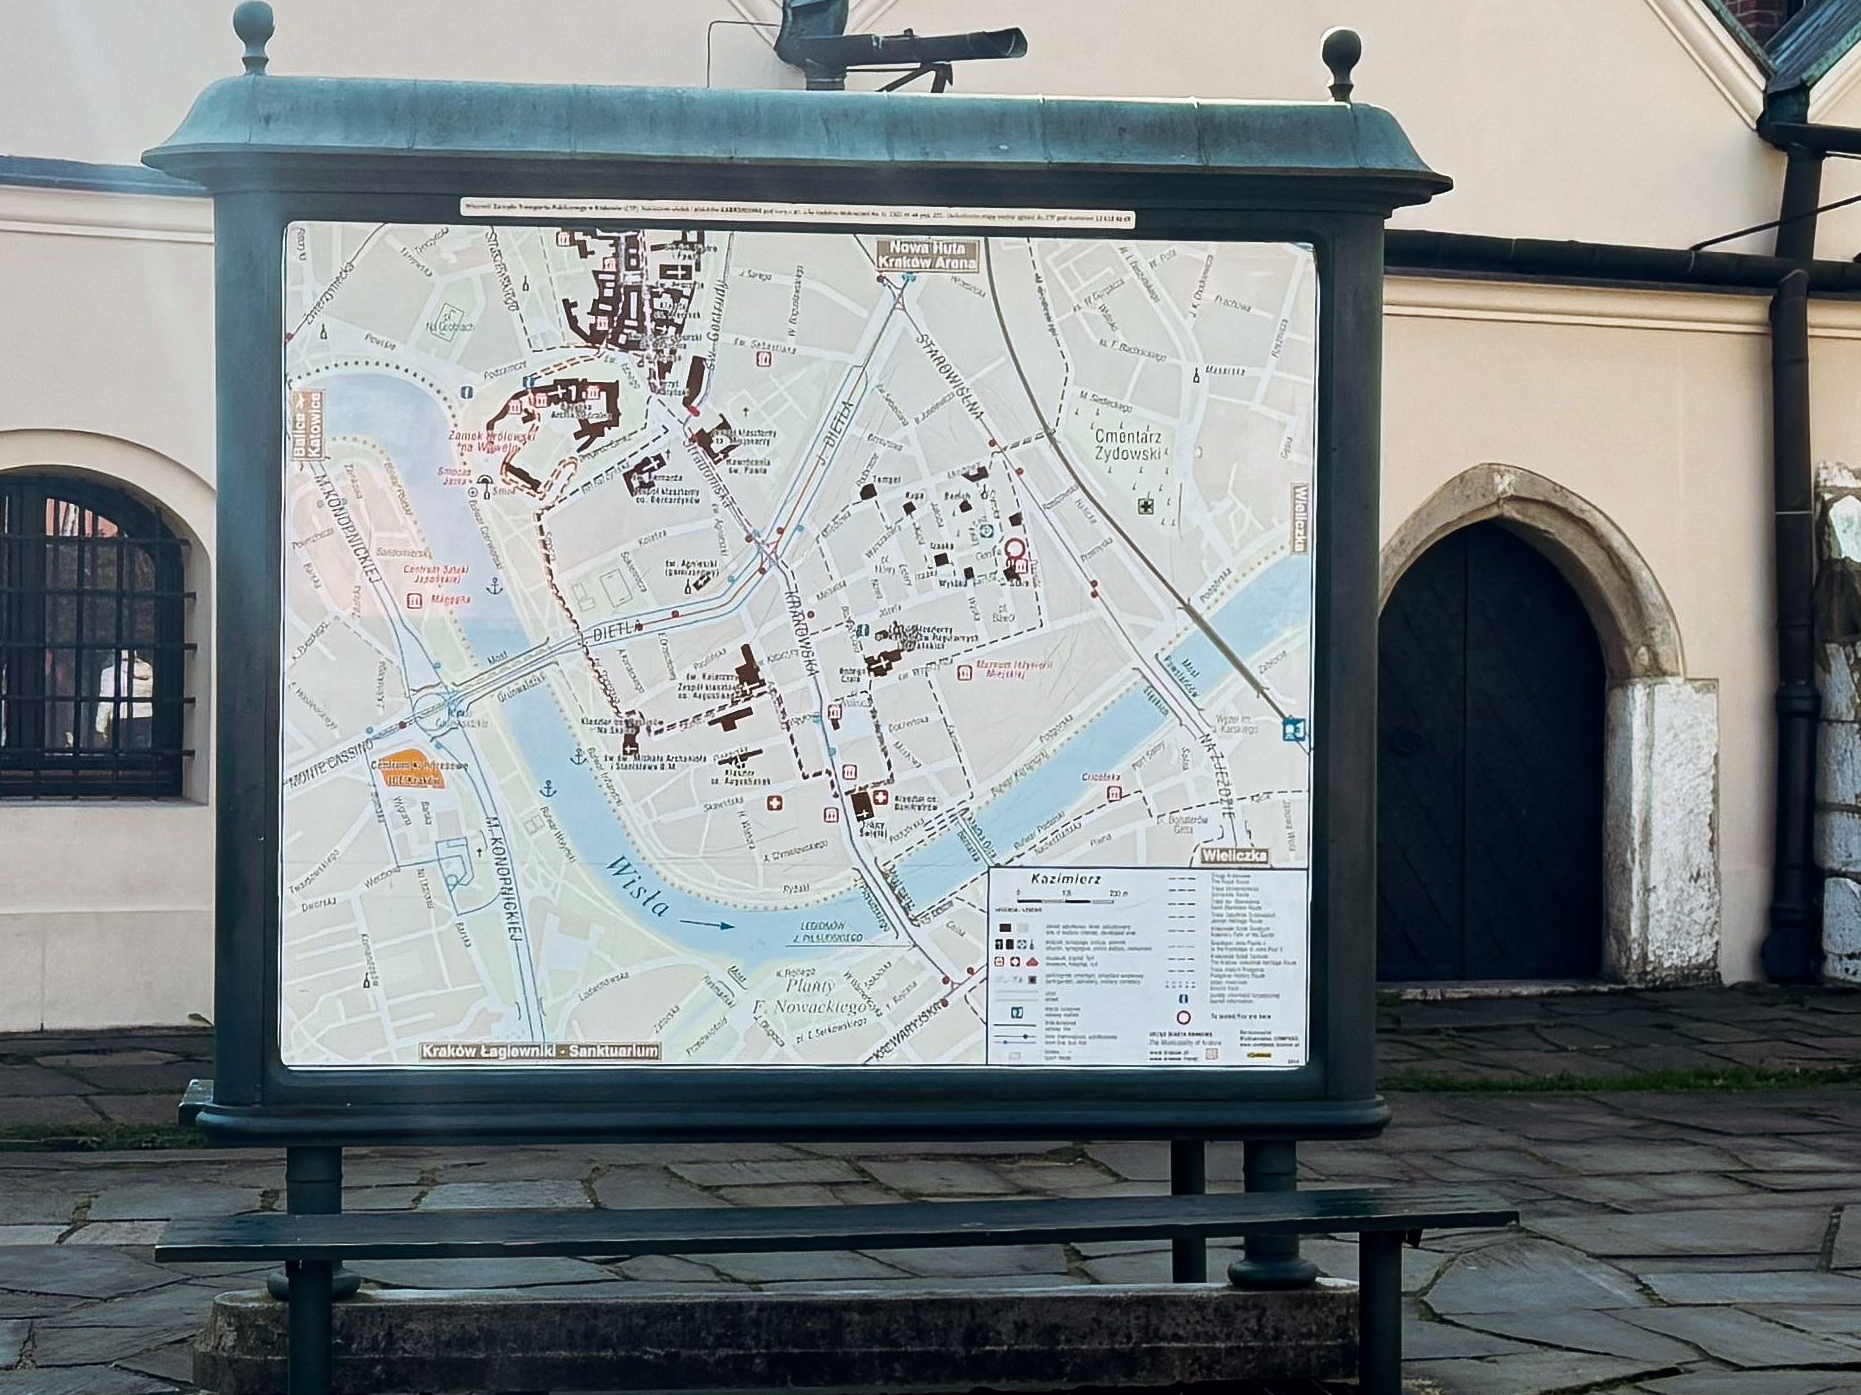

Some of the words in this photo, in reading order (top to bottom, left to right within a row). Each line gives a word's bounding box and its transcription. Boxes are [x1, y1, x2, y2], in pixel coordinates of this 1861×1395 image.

[889, 240, 930, 254] Nowa
[933, 241, 966, 255] Huta
[878, 255, 933, 269] Kraków
[307, 392, 322, 458] Katowice
[826, 400, 854, 449] DIETLA
[1095, 428, 1162, 444] Cmentarz
[1293, 485, 1307, 552] Wieliczka
[593, 621, 642, 642] DIETLA
[325, 738, 374, 770] CASSINO
[1202, 849, 1267, 863] Wieliczka
[606, 855, 670, 918] Wisła
[1031, 873, 1102, 885] Kazimierz
[491, 836, 523, 942] KONOPNICKIEJ
[786, 978, 836, 994] Planty
[776, 998, 869, 1017] Nowackiego
[421, 1044, 479, 1058] Kraków
[480, 1044, 557, 1060] Łagiewniki
[569, 1045, 659, 1059] Sanktuarium
